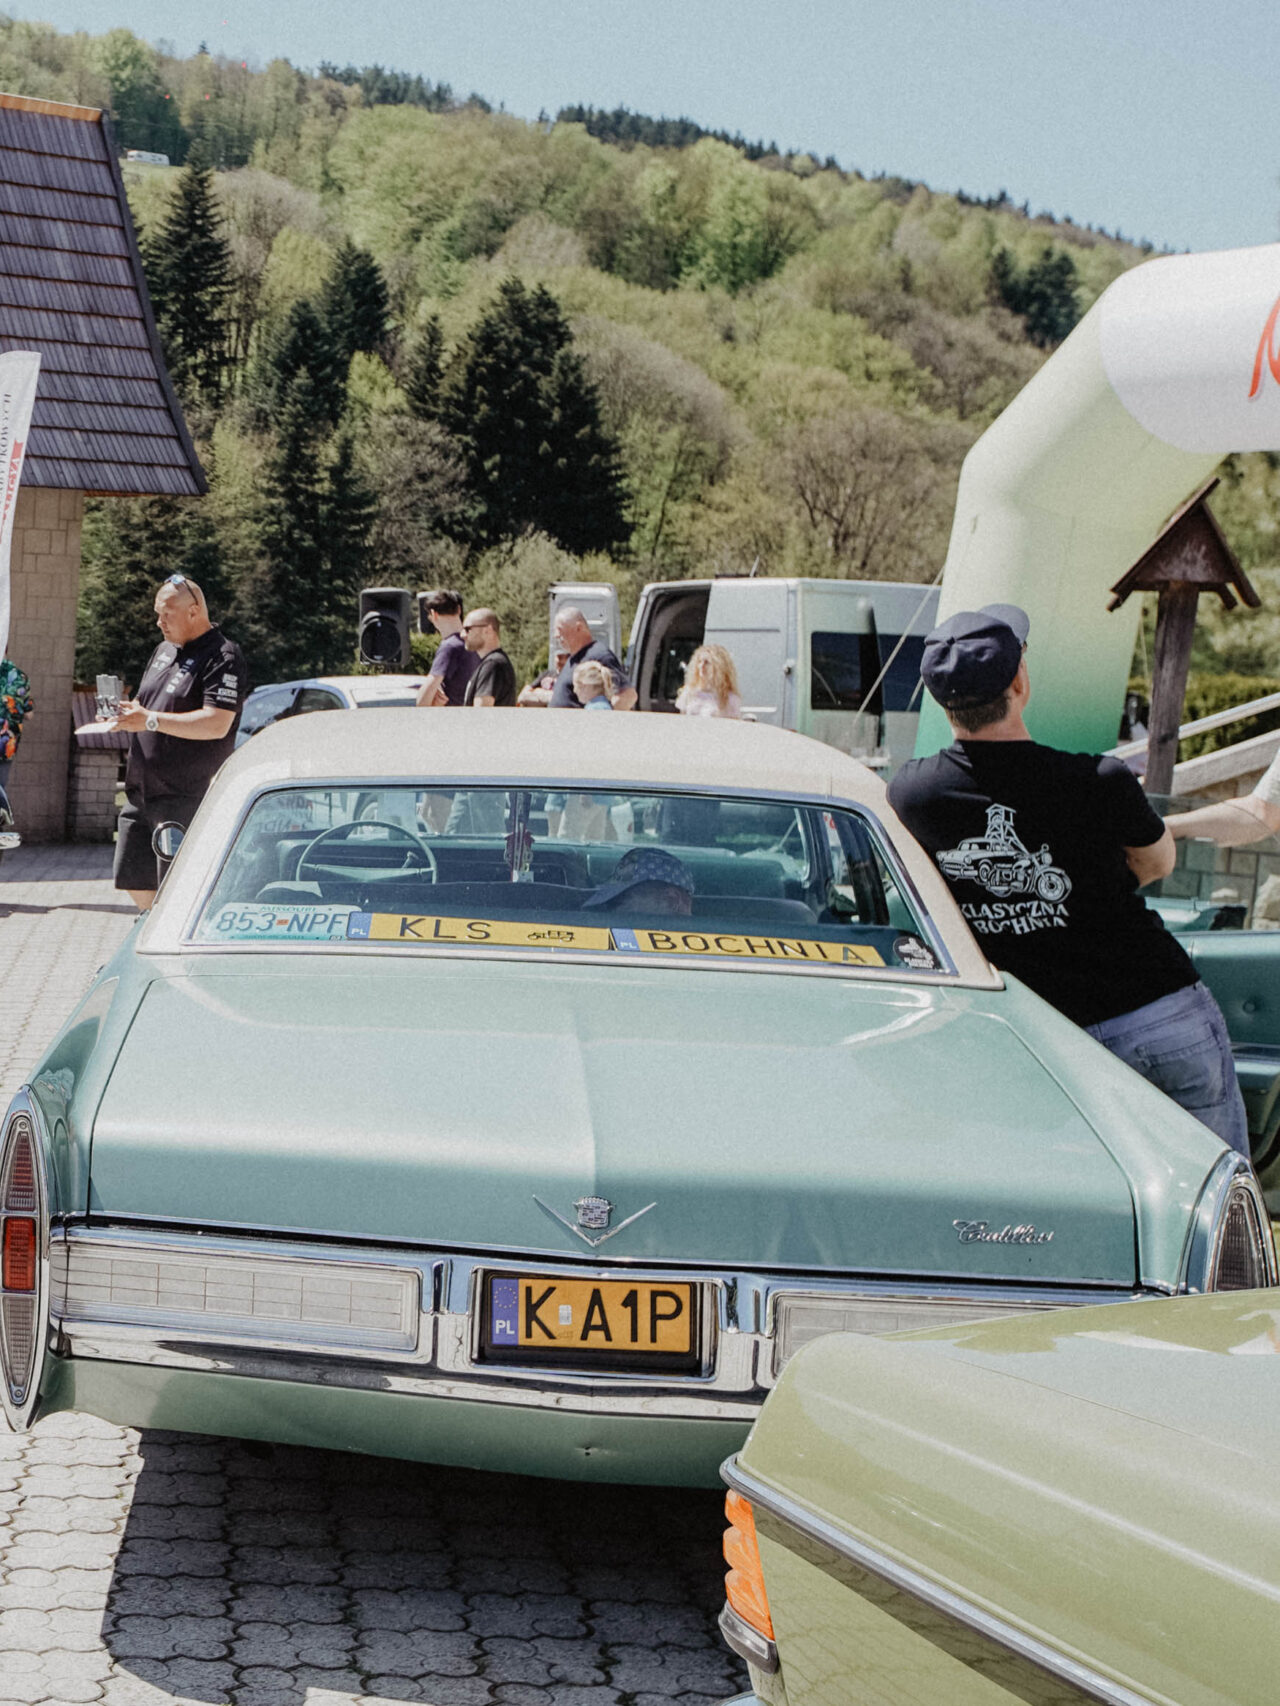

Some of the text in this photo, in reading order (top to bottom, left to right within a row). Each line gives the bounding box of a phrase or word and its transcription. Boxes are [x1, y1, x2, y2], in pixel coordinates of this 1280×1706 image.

[961, 901, 1070, 919] KLASYCZNA
[216, 911, 349, 933] 853 NPF
[351, 928, 367, 936] PL
[399, 917, 491, 940] KLS
[973, 915, 1067, 935] BOCHNIA
[620, 941, 637, 949] PL
[647, 932, 866, 964] BOCHNIA
[952, 1219, 1055, 1244] Cadillac
[525, 1286, 683, 1343] K A1P
[495, 1319, 515, 1335] PL
